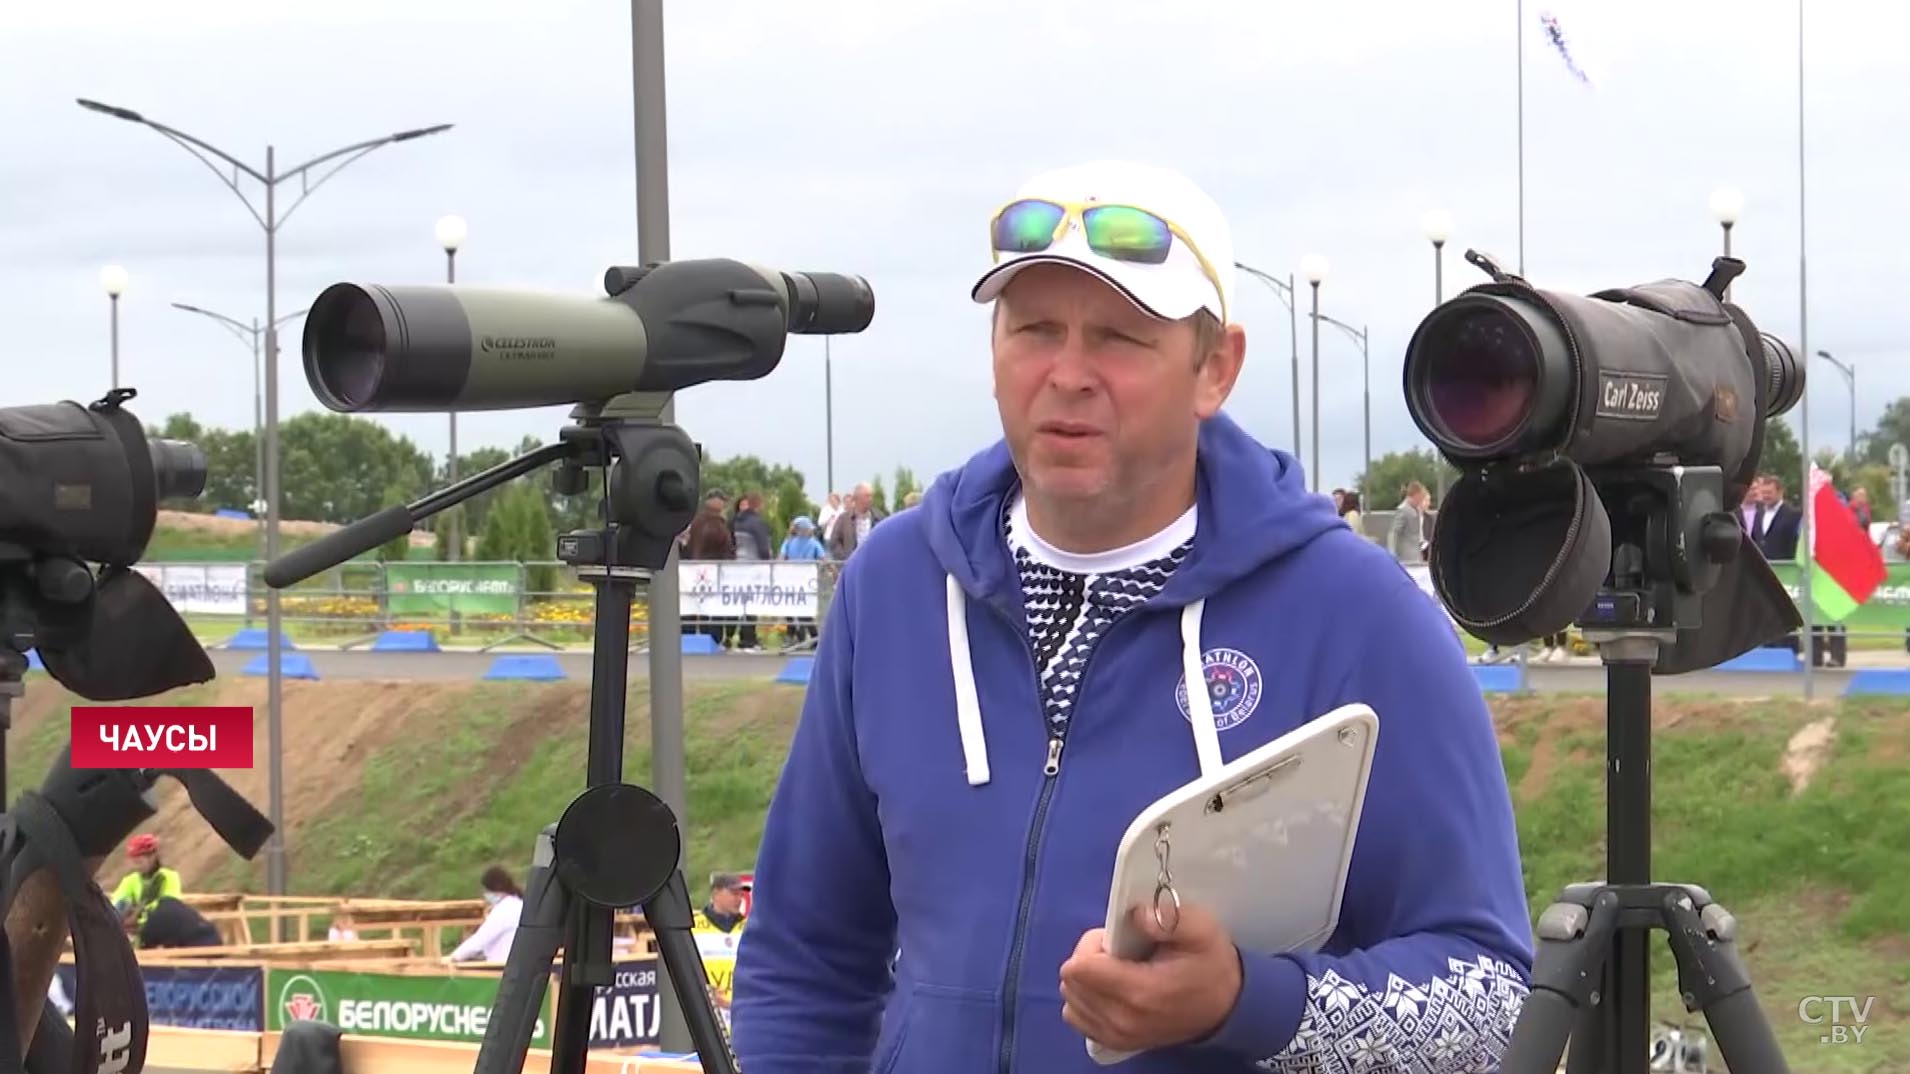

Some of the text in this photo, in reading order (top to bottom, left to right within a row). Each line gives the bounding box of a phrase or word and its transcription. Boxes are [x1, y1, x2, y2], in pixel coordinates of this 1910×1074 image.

[1604, 381, 1660, 411] Carl Zeiss
[721, 585, 808, 606] БИАТЛОНА
[1204, 652, 1255, 678] ATHLON
[338, 1000, 544, 1039] БЕЛОРУСНЕ
